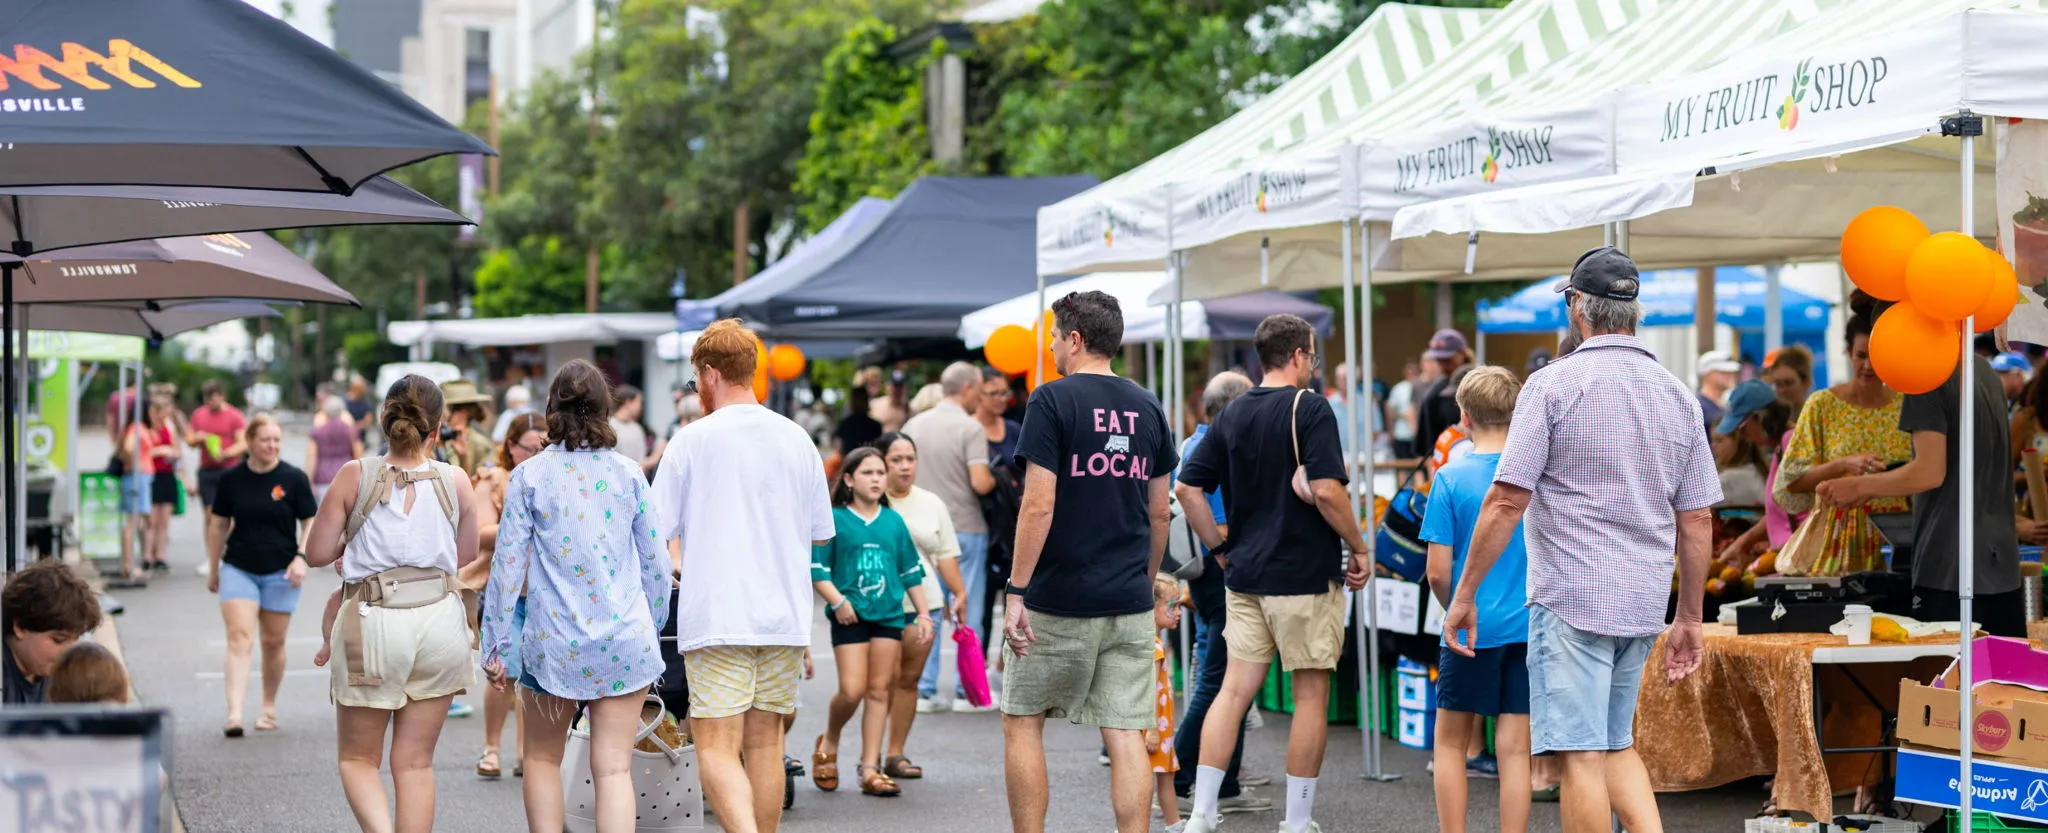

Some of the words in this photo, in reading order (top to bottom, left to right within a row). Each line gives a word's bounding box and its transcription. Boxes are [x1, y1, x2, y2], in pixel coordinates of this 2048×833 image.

[0, 97, 85, 112] SVILLE
[1660, 95, 1701, 142] MY
[1701, 75, 1778, 134] FRUIT
[1810, 56, 1887, 113] SHOP
[1394, 153, 1421, 193] MY
[1425, 136, 1479, 186] FRUIT
[1501, 125, 1554, 169] SHOP
[1093, 408, 1139, 434] EAT
[1071, 452, 1149, 480] LOCAL
[1973, 774, 1996, 783] APPLES
